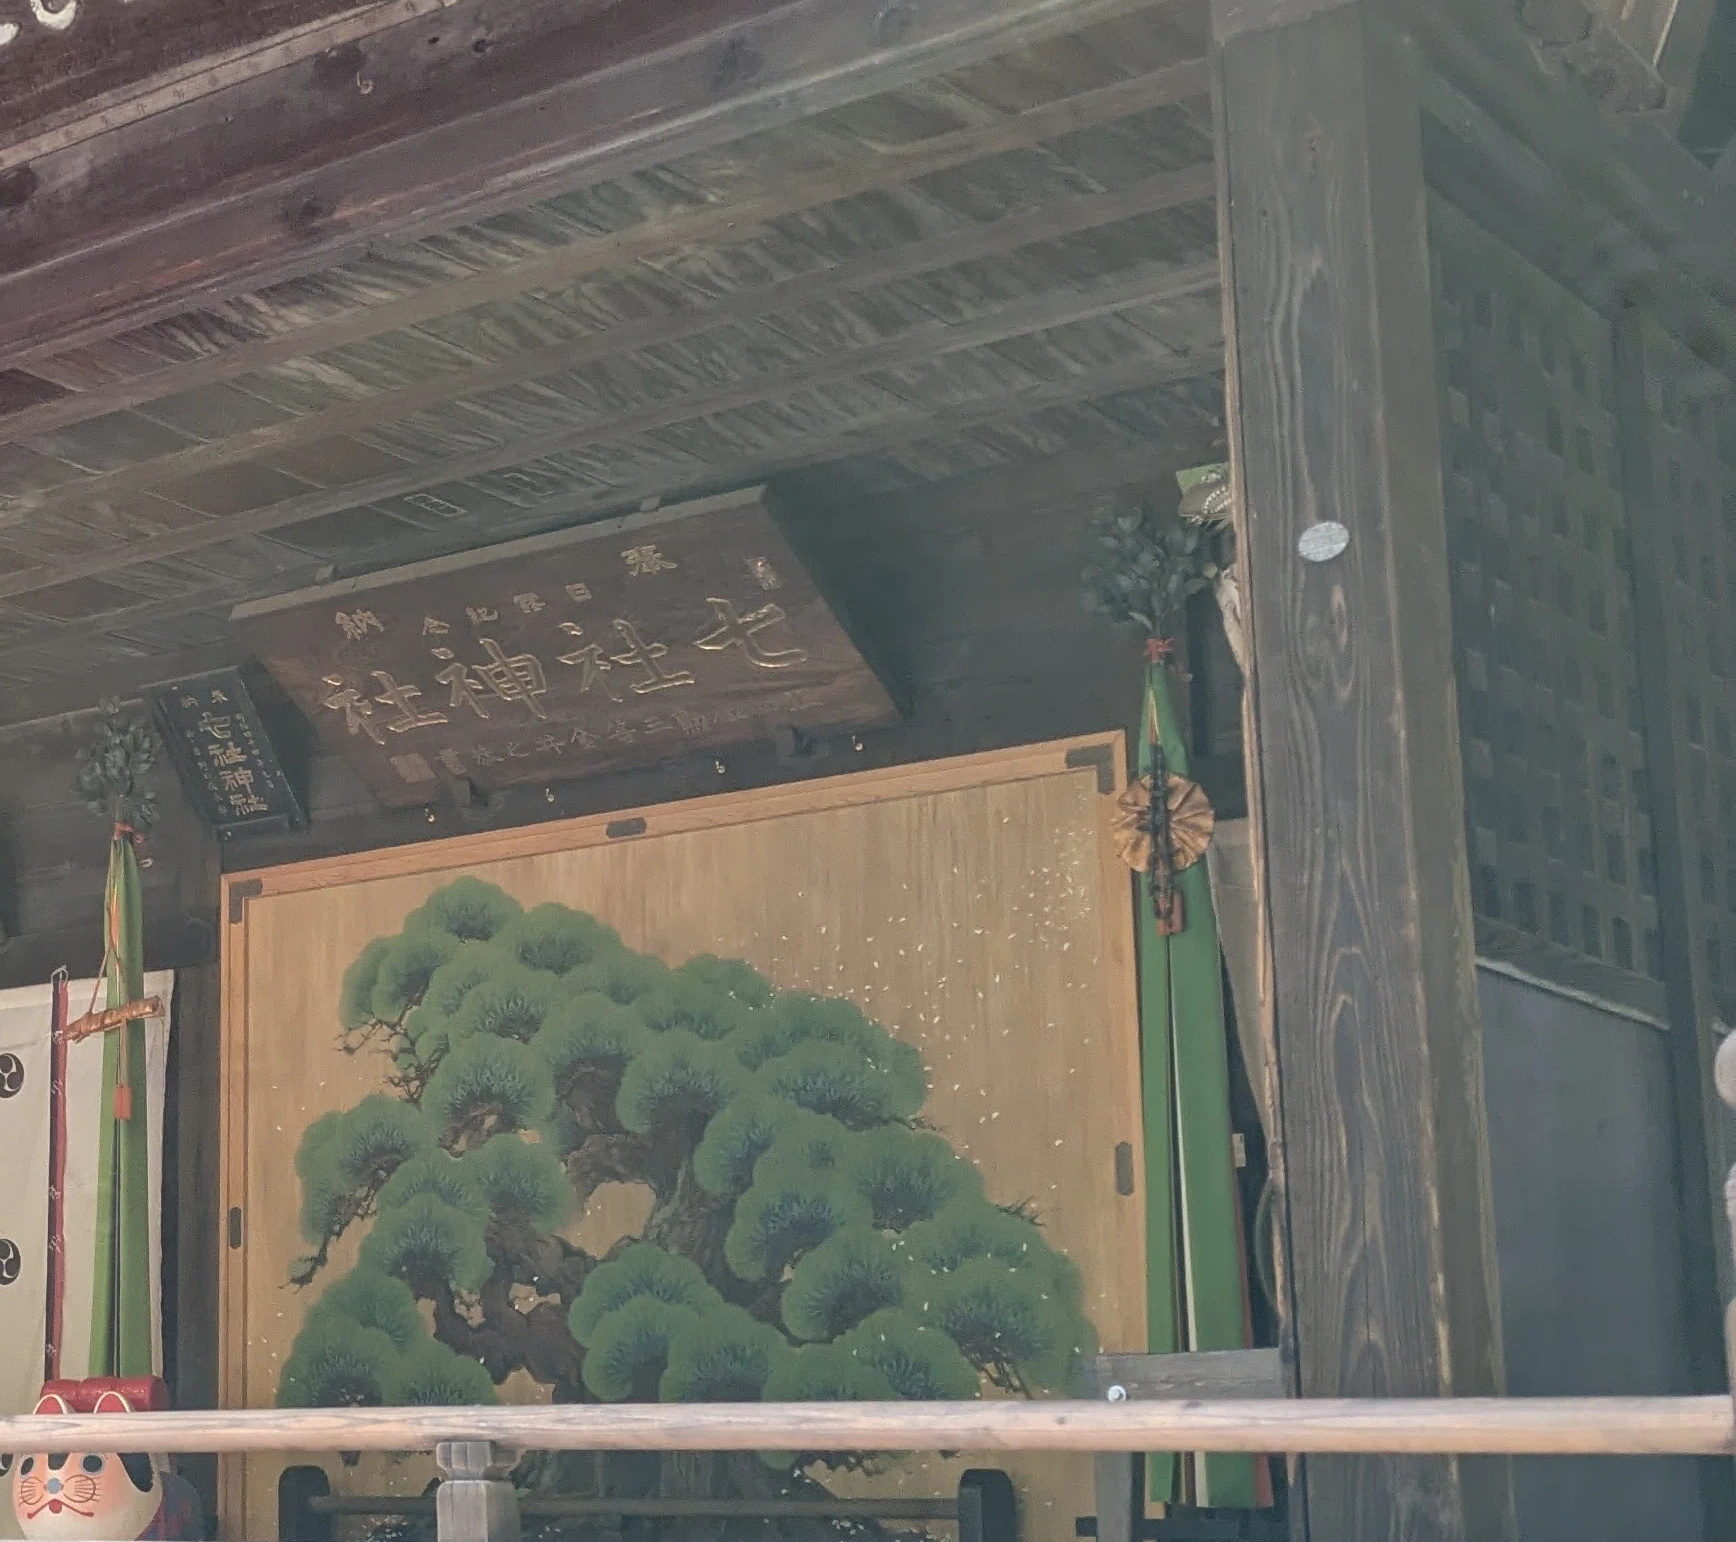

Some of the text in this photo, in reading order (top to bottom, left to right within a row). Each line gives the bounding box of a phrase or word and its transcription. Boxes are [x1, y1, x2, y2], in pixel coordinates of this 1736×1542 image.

[321, 595, 811, 746] 七社神社
[197, 711, 269, 817] 七社神社
